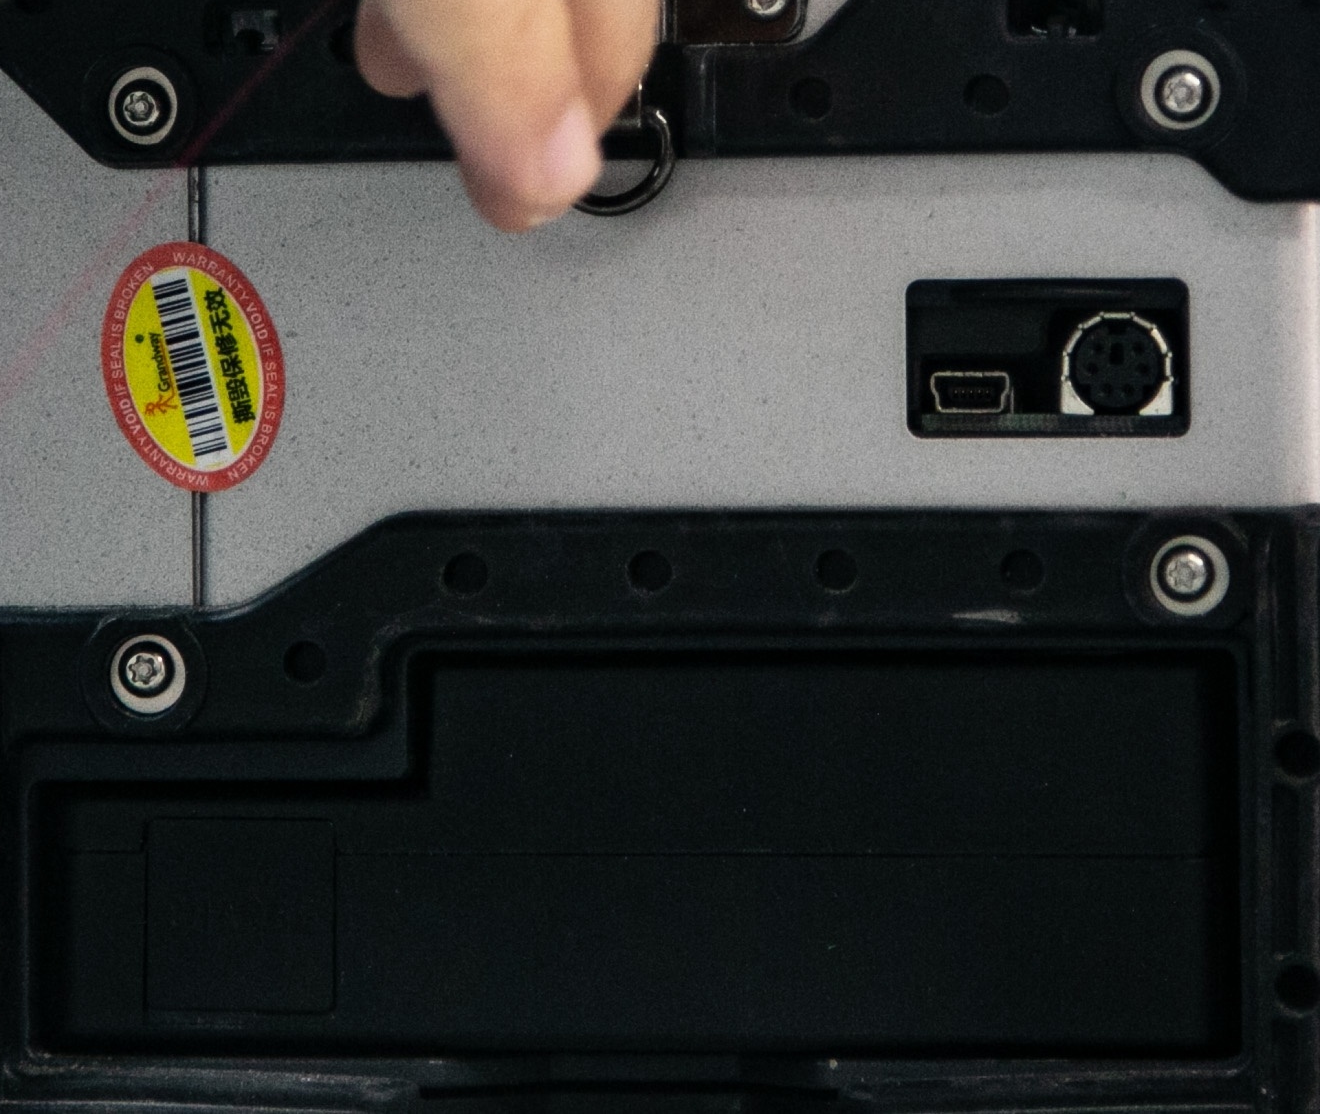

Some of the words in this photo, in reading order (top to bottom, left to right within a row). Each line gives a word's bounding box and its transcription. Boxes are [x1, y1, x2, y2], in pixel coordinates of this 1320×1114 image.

[114, 262, 155, 320] BROKEN
[173, 251, 249, 301] WARRANTY
[111, 322, 124, 342] IS
[246, 301, 269, 341] VOID
[111, 344, 124, 380] SEAL
[148, 332, 170, 392] Grandway
[203, 286, 257, 424] 撕毁保修无效
[261, 342, 274, 358] IF
[113, 380, 126, 396] IF
[264, 361, 278, 396] SEAL
[118, 397, 144, 436] VOID
[264, 400, 277, 421] IS
[136, 435, 209, 486] WARRANTY
[228, 424, 273, 480] BROKEN
